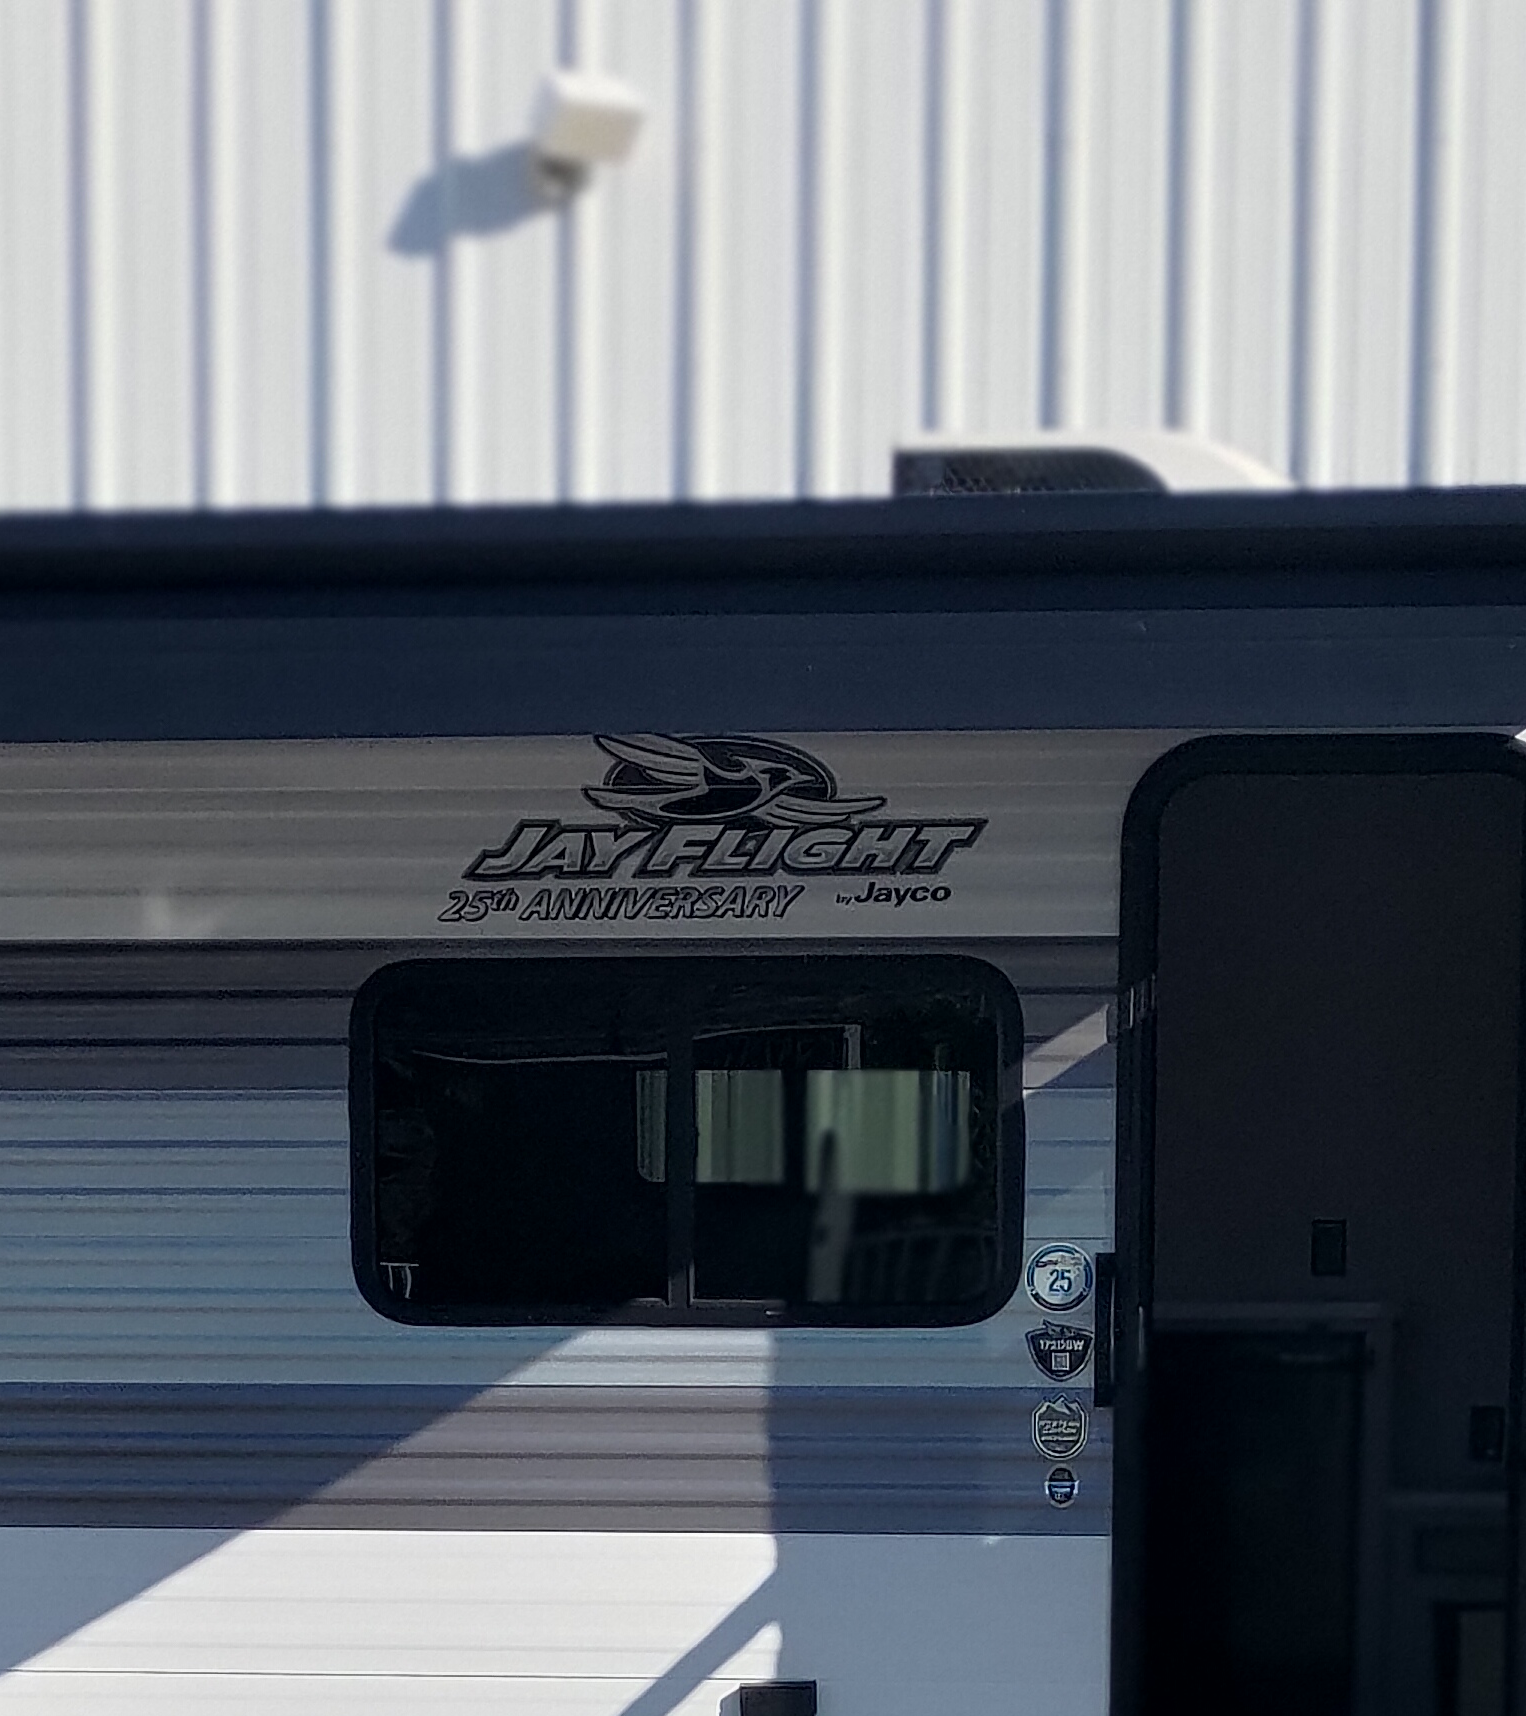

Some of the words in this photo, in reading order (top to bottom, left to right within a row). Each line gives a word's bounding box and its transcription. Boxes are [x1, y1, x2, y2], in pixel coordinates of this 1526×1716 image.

[462, 818, 659, 880] JAY
[631, 817, 989, 879] FLIGHT
[436, 888, 520, 922] 25th
[518, 885, 807, 921] ANNIVERSARY
[853, 881, 952, 908] Jayco
[1048, 1268, 1073, 1293] 25
